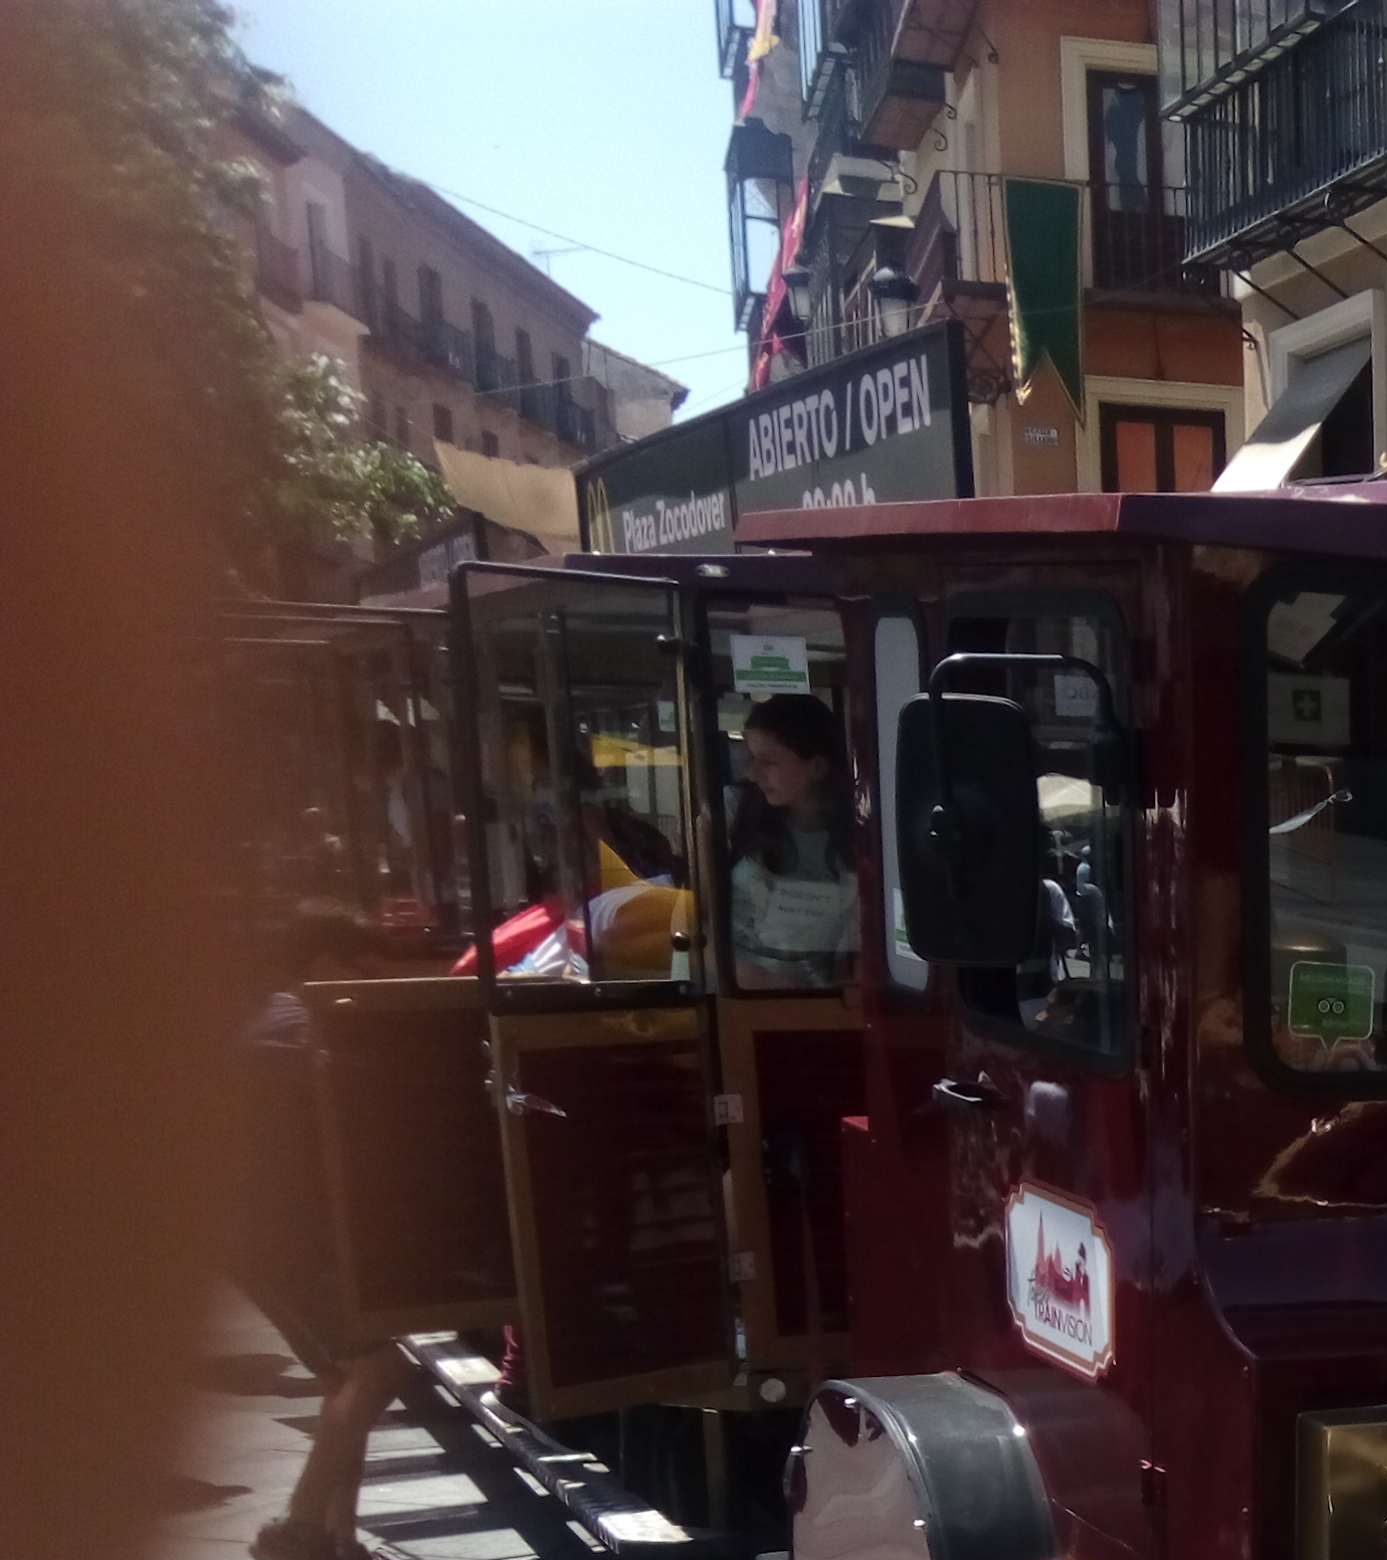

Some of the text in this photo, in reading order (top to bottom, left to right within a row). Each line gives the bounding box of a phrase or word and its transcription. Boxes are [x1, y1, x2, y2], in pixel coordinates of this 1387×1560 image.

[749, 388, 838, 481] ABIERTO
[858, 353, 932, 446] OPEN
[622, 489, 726, 553] Plaza Zocodover
